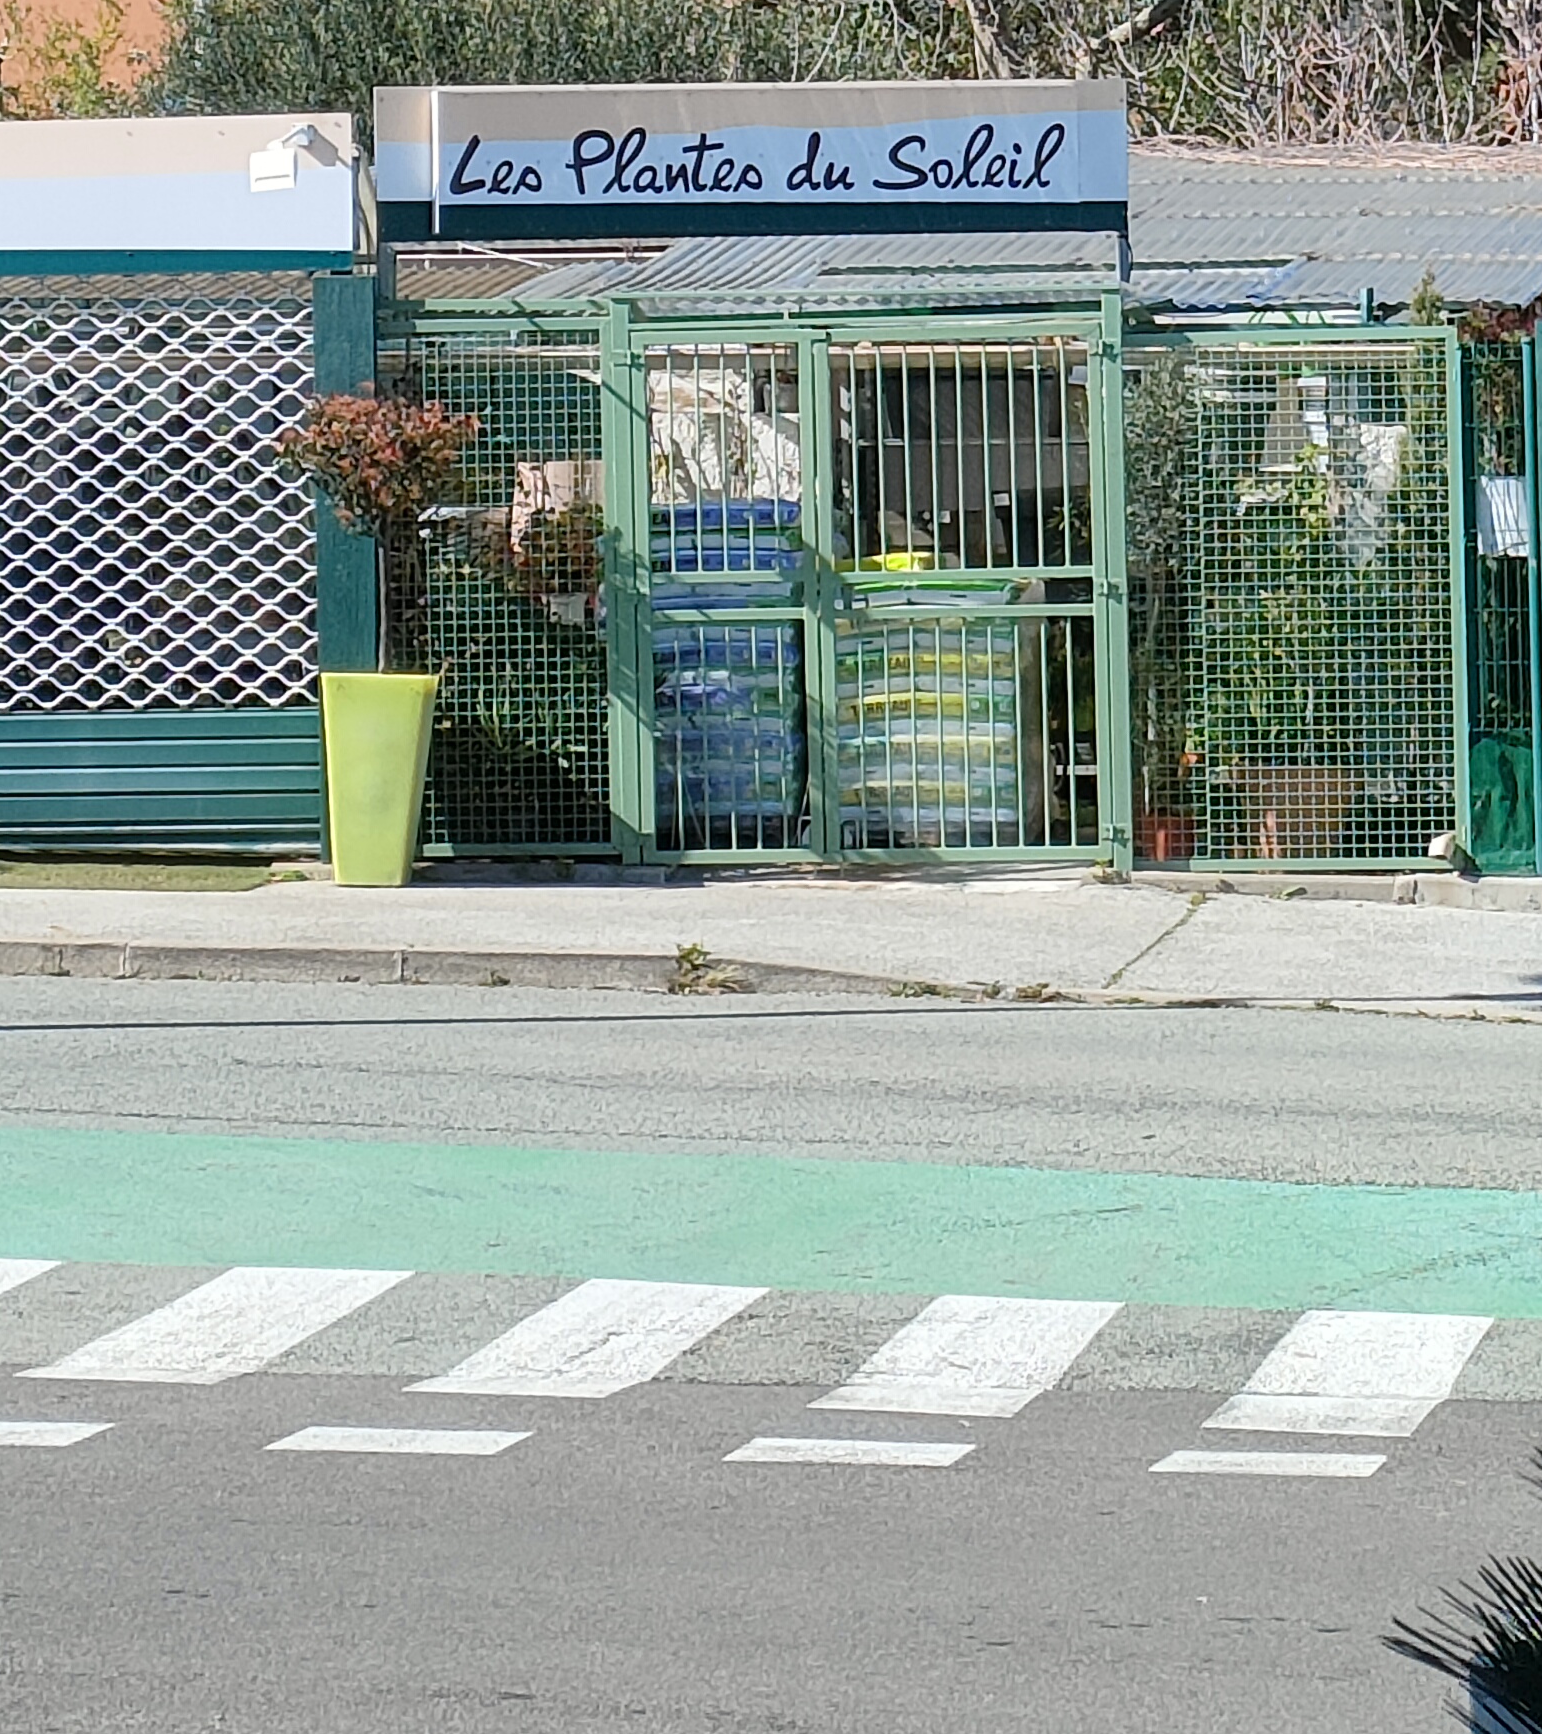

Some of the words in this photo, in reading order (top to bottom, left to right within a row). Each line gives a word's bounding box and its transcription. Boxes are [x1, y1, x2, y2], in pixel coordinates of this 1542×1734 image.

[449, 134, 542, 195] Les
[565, 127, 763, 195] Plantes
[786, 131, 855, 191] du
[872, 123, 1065, 191] Soleil
